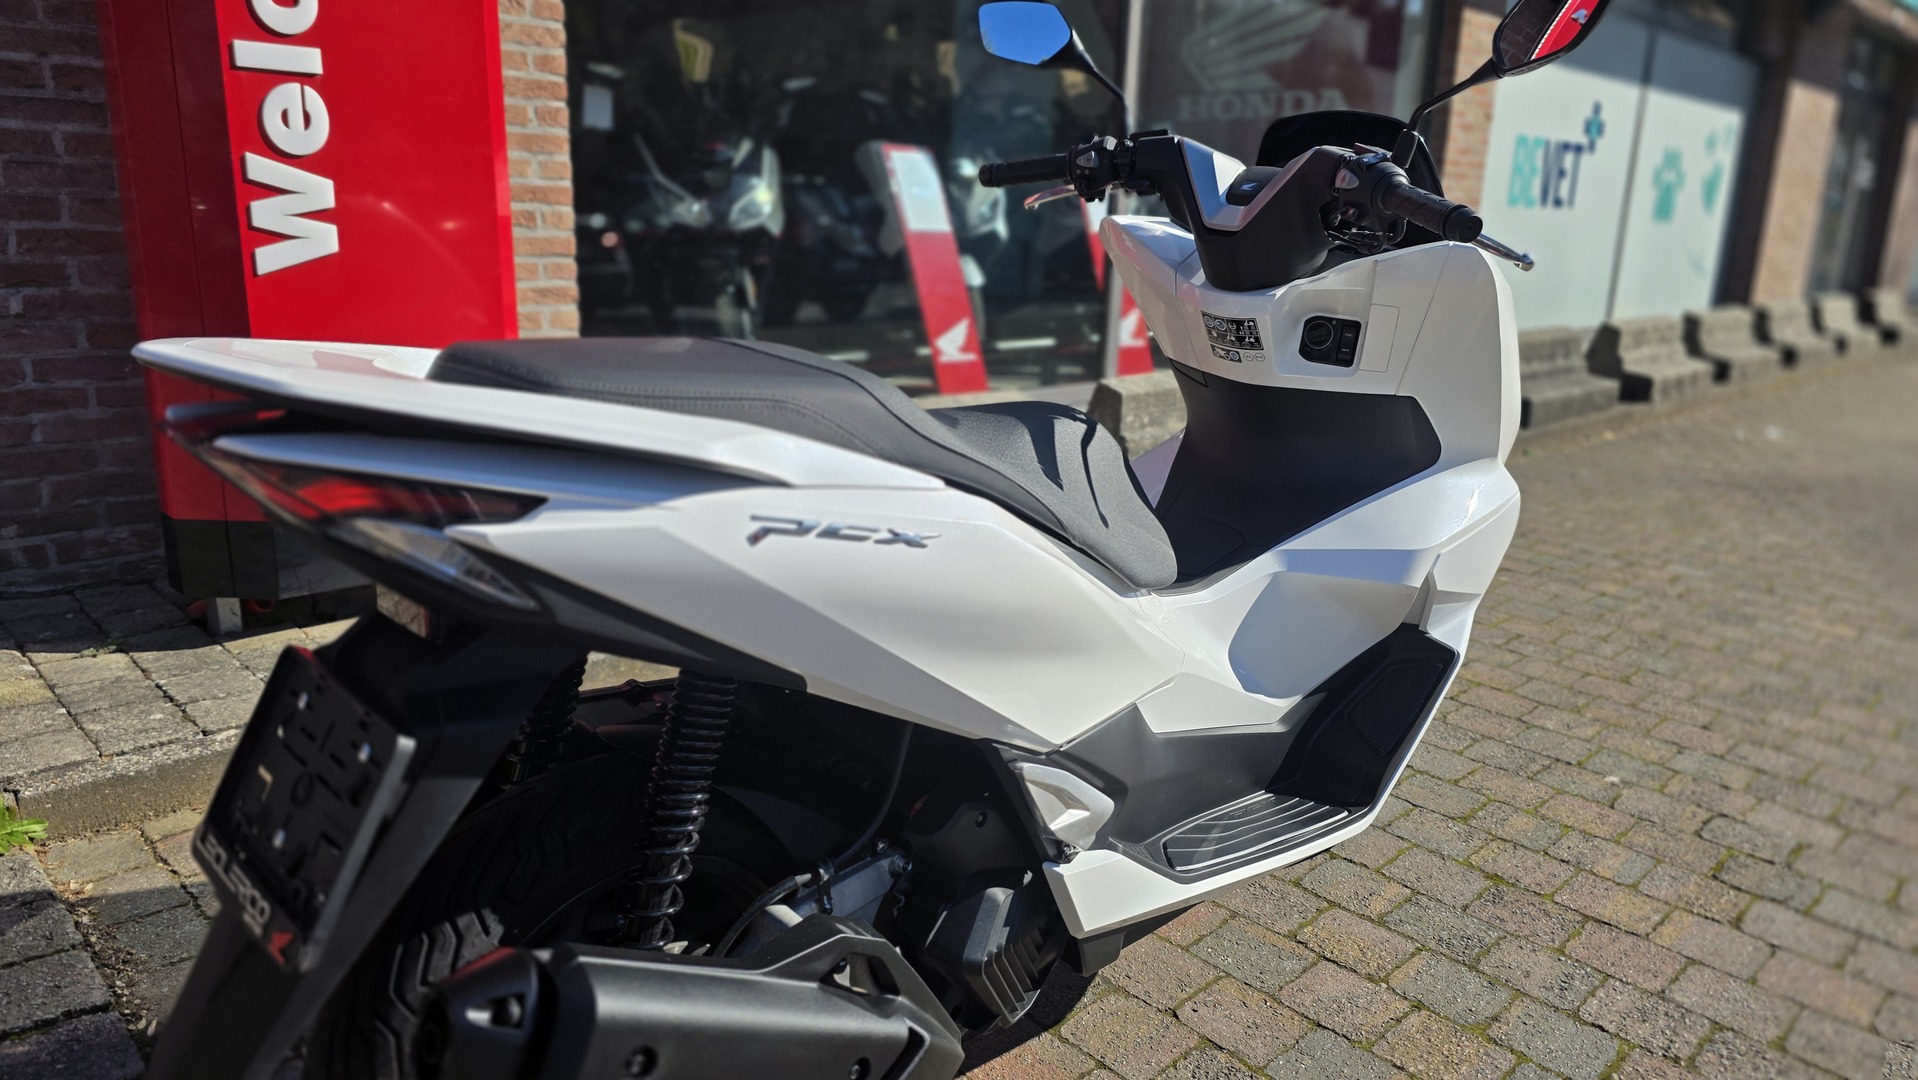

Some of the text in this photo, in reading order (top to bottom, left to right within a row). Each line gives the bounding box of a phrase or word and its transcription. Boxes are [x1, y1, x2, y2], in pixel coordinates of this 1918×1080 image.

[1178, 88, 1349, 121] HONDA
[1507, 132, 1585, 209] BEVET
[746, 513, 943, 549] PCX
